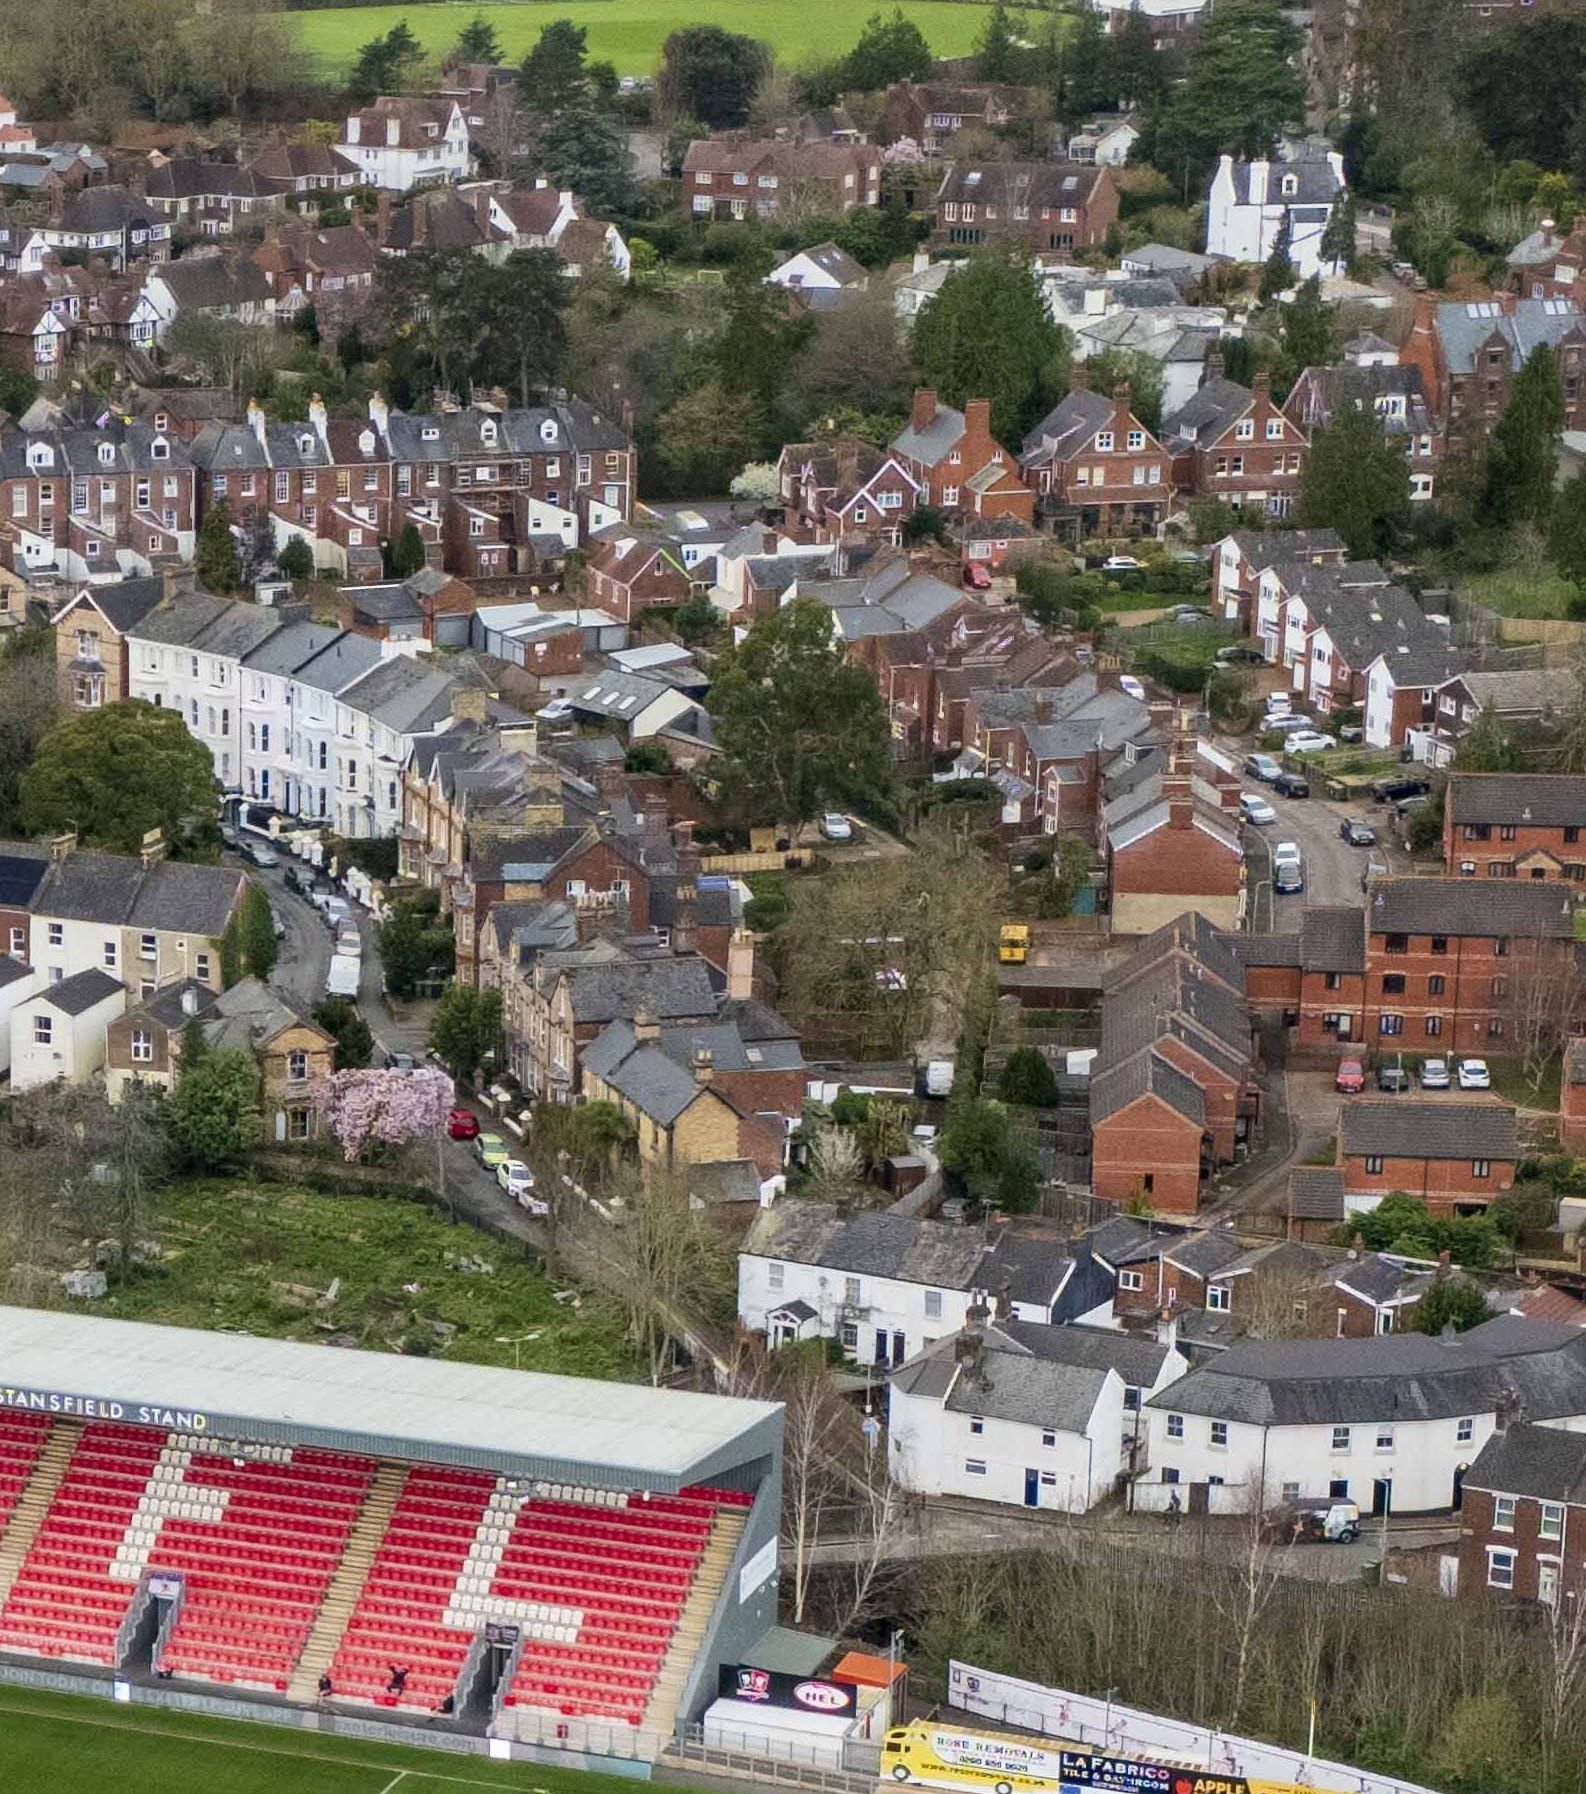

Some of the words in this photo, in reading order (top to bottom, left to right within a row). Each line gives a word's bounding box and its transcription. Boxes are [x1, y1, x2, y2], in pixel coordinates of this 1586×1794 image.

[138, 1407, 207, 1430] STAND
[2, 1668, 35, 1684] JOIN
[40, 1673, 87, 1691] TODAY
[937, 1737, 969, 1750] ROSE
[976, 1741, 1045, 1761] REMOVALS
[1063, 1753, 1087, 1768] LA
[1091, 1757, 1171, 1779] FABRICO
[1064, 1767, 1089, 1779] TILE
[1092, 1772, 1100, 1781] &
[1104, 1774, 1169, 1791] BATHROOM
